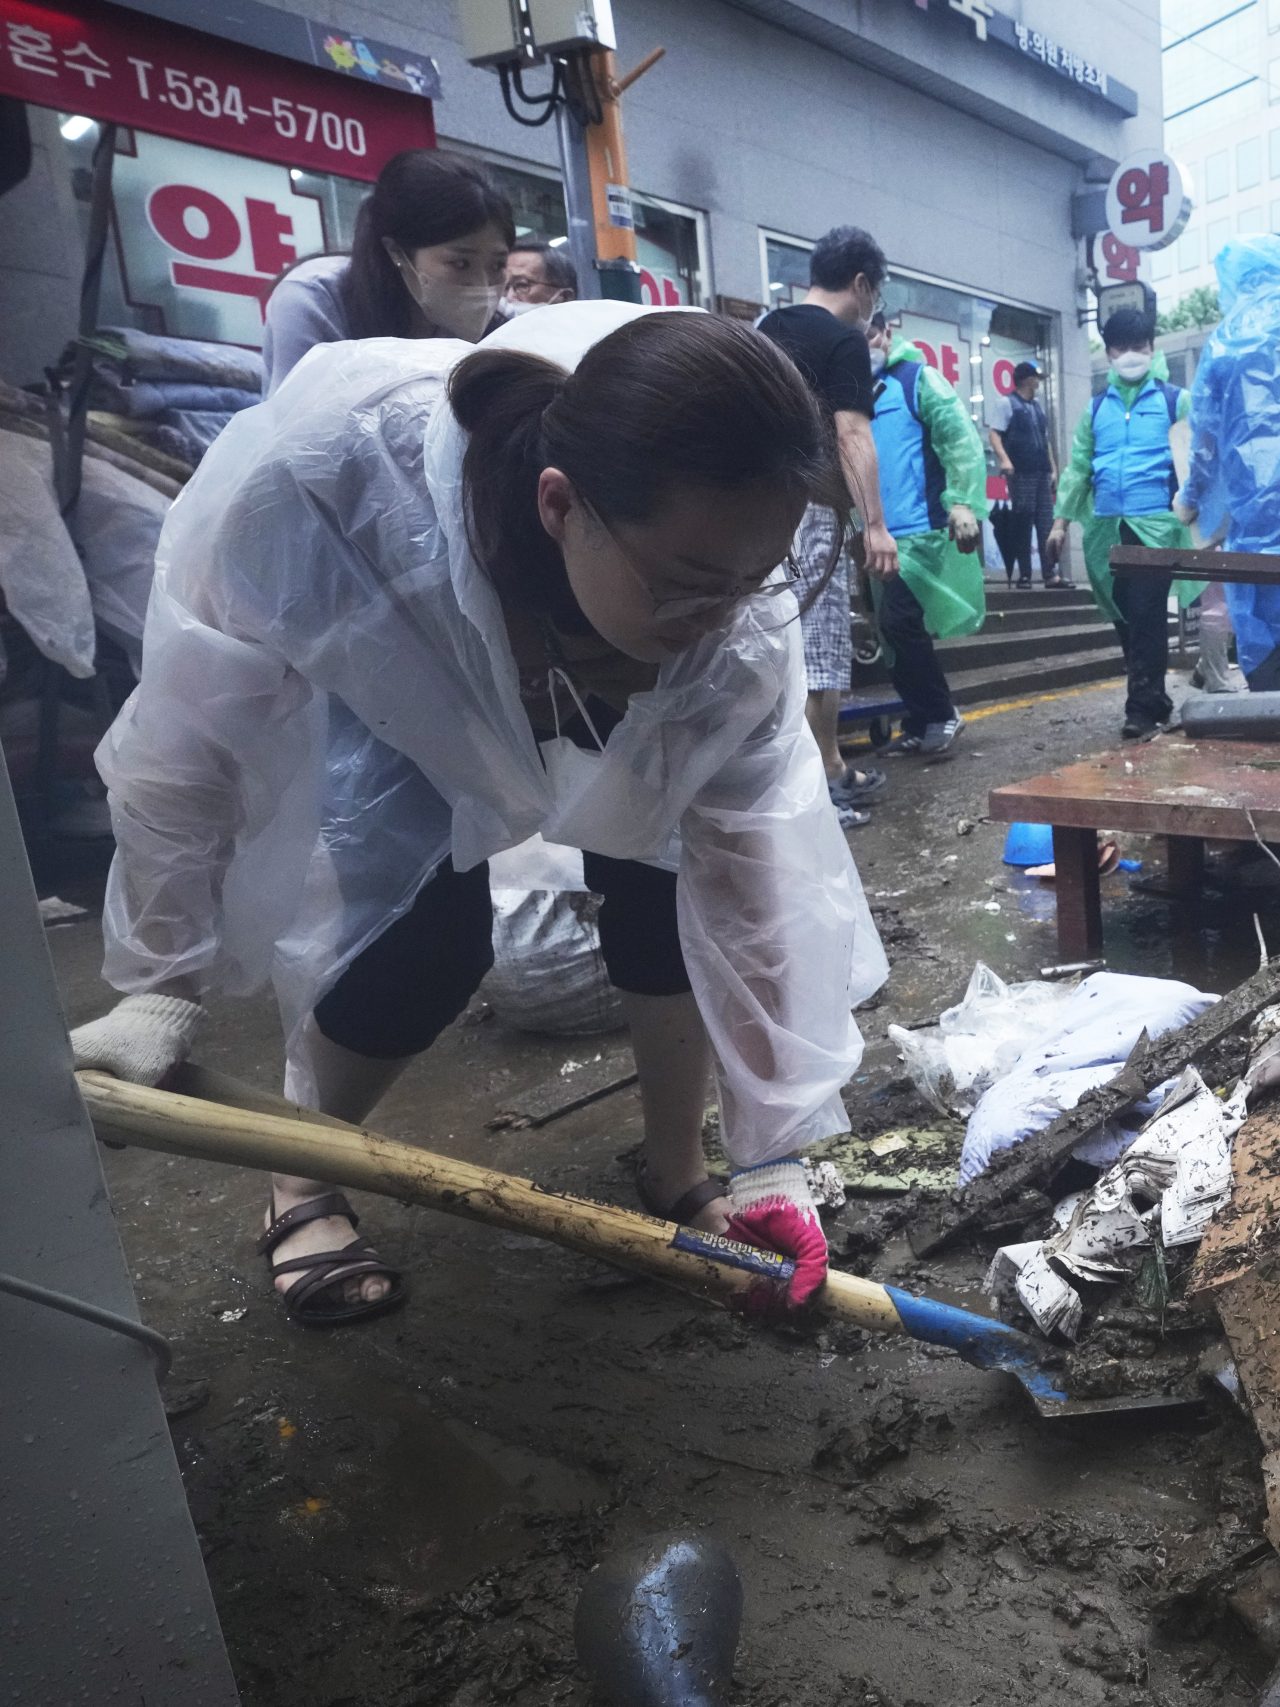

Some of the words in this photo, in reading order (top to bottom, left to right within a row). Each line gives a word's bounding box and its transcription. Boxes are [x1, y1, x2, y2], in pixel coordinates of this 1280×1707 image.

[7, 22, 112, 88] 혼수
[127, 56, 367, 156] T.534-5700
[1116, 161, 1170, 233] 약
